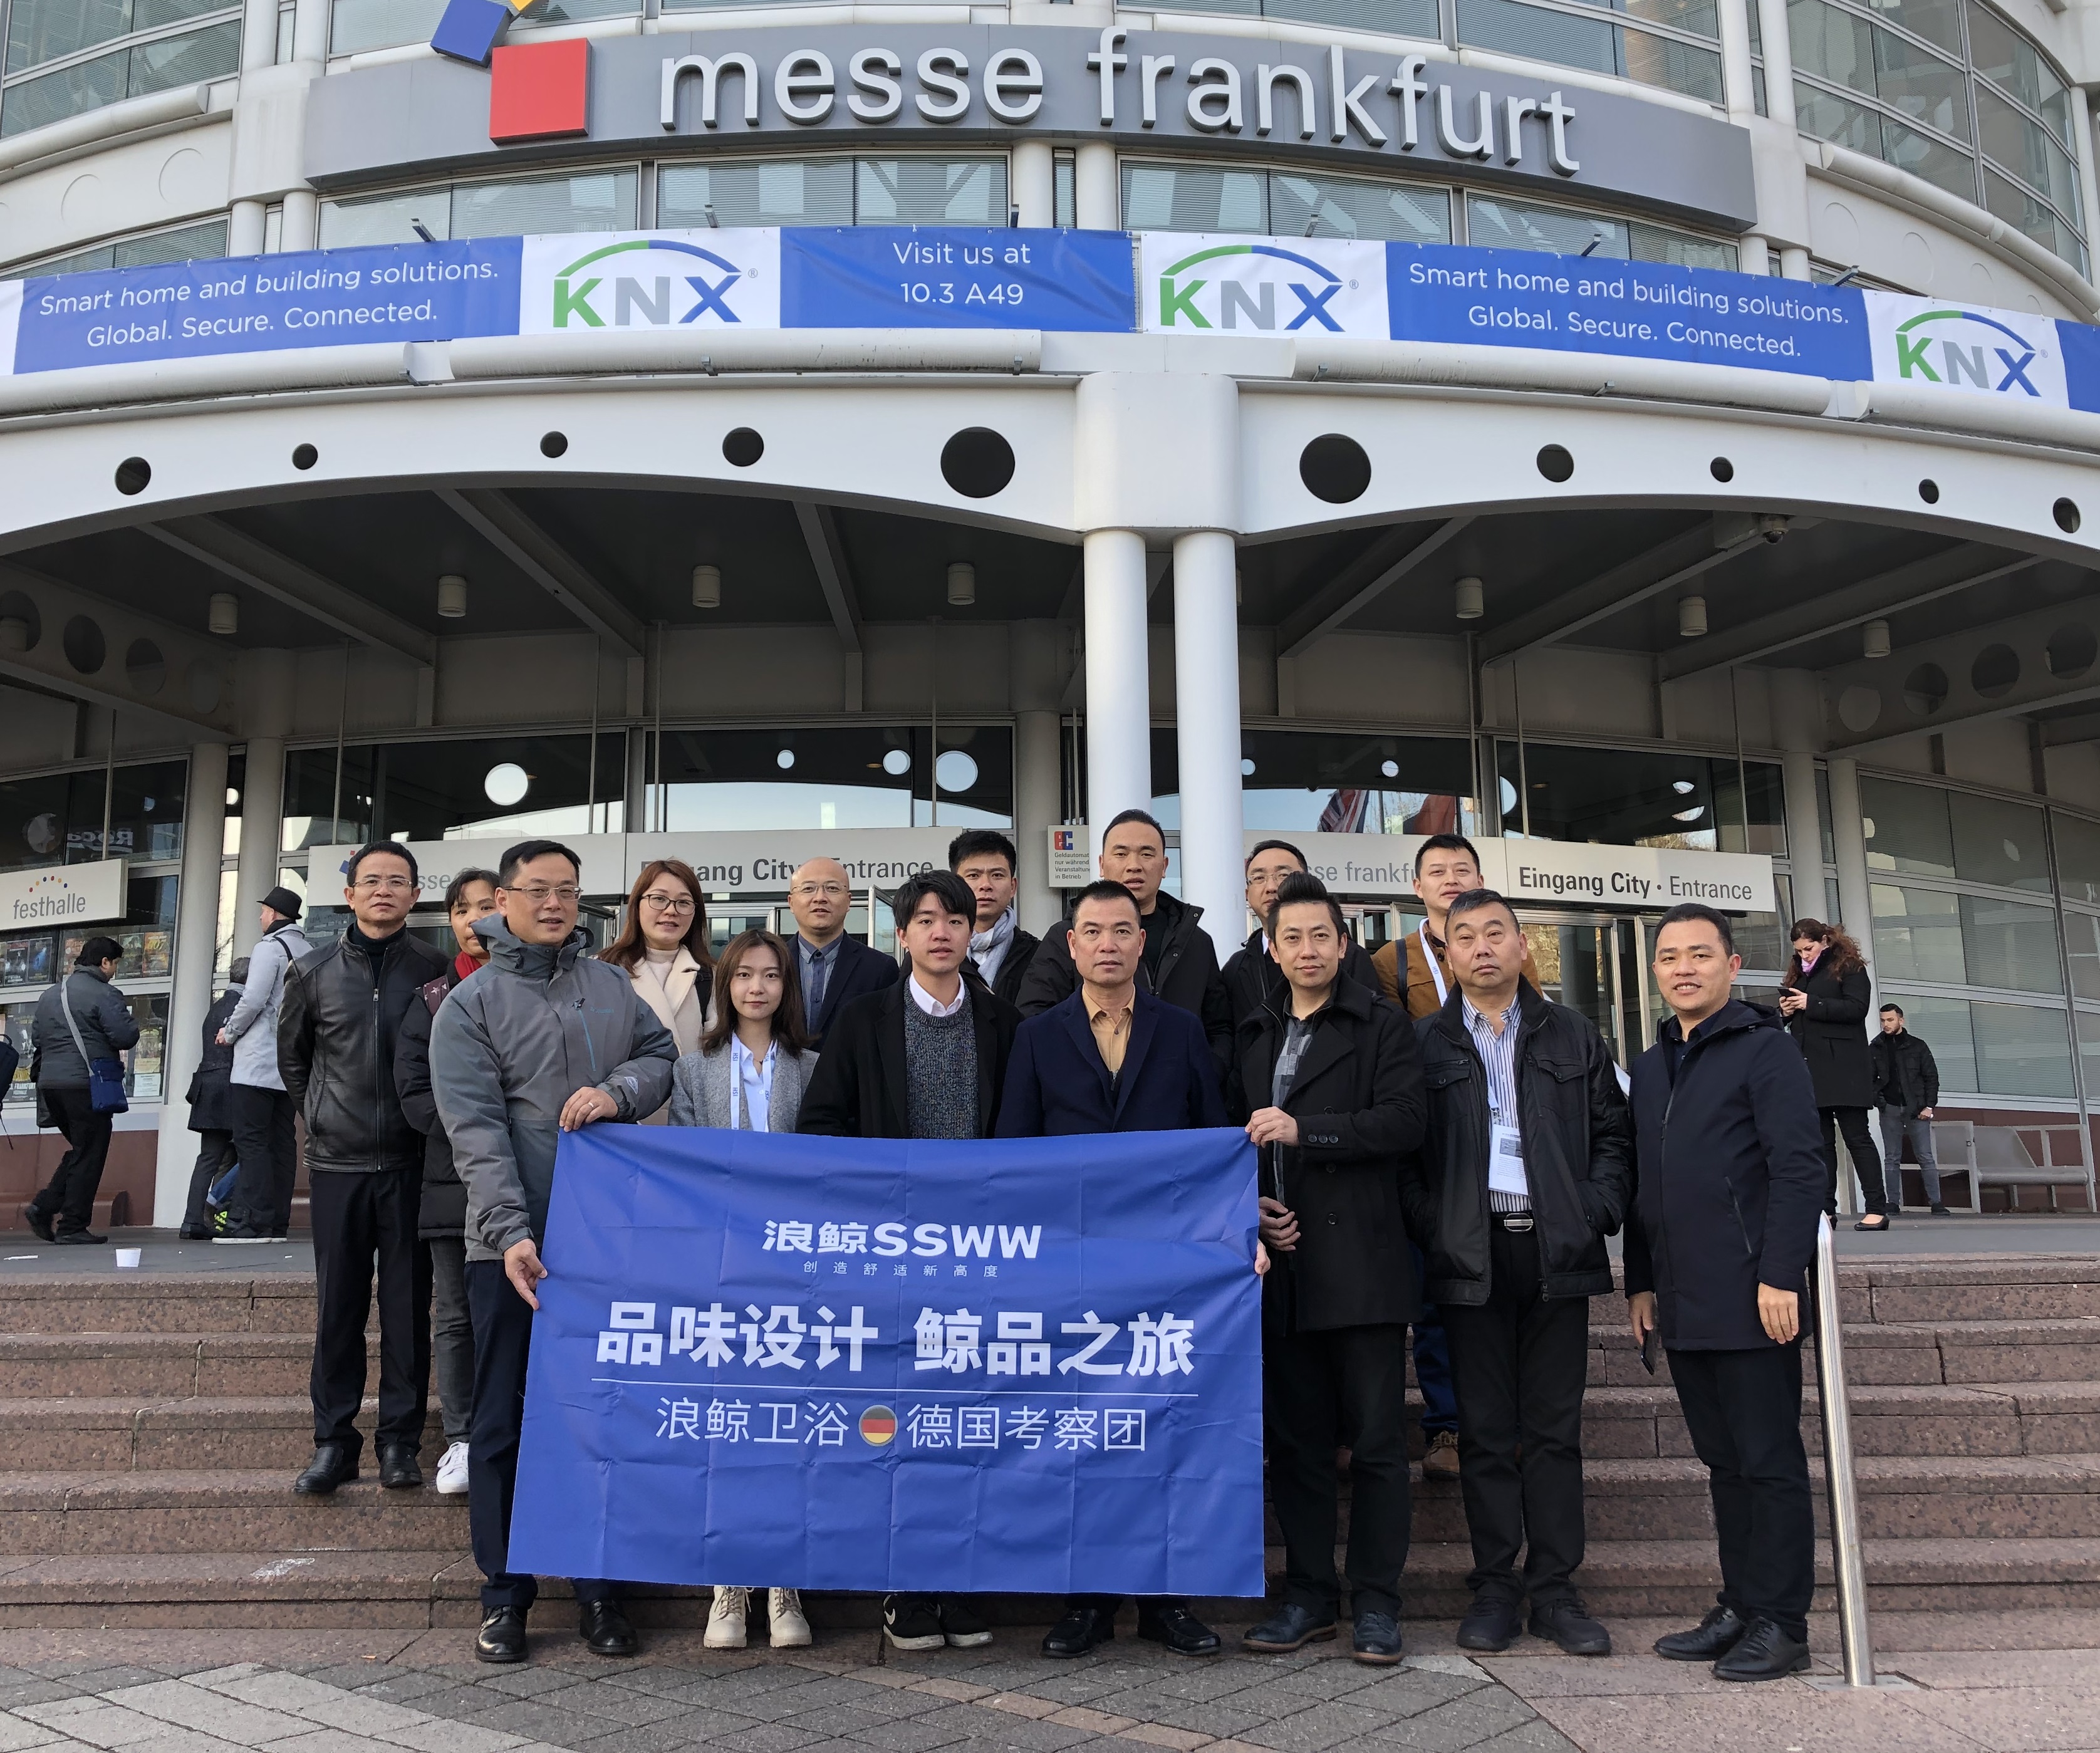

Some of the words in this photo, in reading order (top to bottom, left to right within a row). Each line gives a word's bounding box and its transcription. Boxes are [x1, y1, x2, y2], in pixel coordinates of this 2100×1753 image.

[661, 48, 1044, 130] messe
[1086, 25, 1580, 177] frankfurt
[893, 241, 954, 264] Visit
[964, 247, 994, 264] us
[1004, 244, 1031, 264] at
[39, 290, 113, 315] Smart
[120, 285, 191, 306] home
[199, 274, 246, 299] and
[255, 261, 361, 294] building
[370, 260, 498, 284] solutions.
[553, 275, 742, 327] KNX
[900, 283, 954, 304] 10.3
[965, 283, 1024, 305] A49
[1160, 278, 1346, 333] KNX
[1410, 263, 1488, 288] Smart
[1497, 268, 1570, 294] home
[1578, 278, 1624, 299] and
[1633, 279, 1729, 314] building
[1737, 295, 1849, 323] solutions.
[87, 320, 172, 347] Global.
[182, 315, 274, 338] Secure.
[284, 299, 437, 328] Connected.
[1468, 305, 1558, 331] Global.
[1567, 311, 1658, 340] Secure.
[1667, 322, 1801, 358] Connected.
[1896, 333, 2041, 397] KNX
[830, 857, 933, 878] ntrance
[1519, 866, 1603, 897] Eingang
[1611, 871, 1651, 899] City
[1670, 875, 1752, 900] Entrance
[13, 893, 86, 920] festhalle
[761, 1219, 1042, 1259] 浪鲸SSWW
[596, 1301, 878, 1372] 品味设计
[913, 1307, 1195, 1377] 鲸品之旅
[655, 1395, 850, 1447] 浪鲸卫浴
[906, 1403, 1146, 1452] 德国考察团
